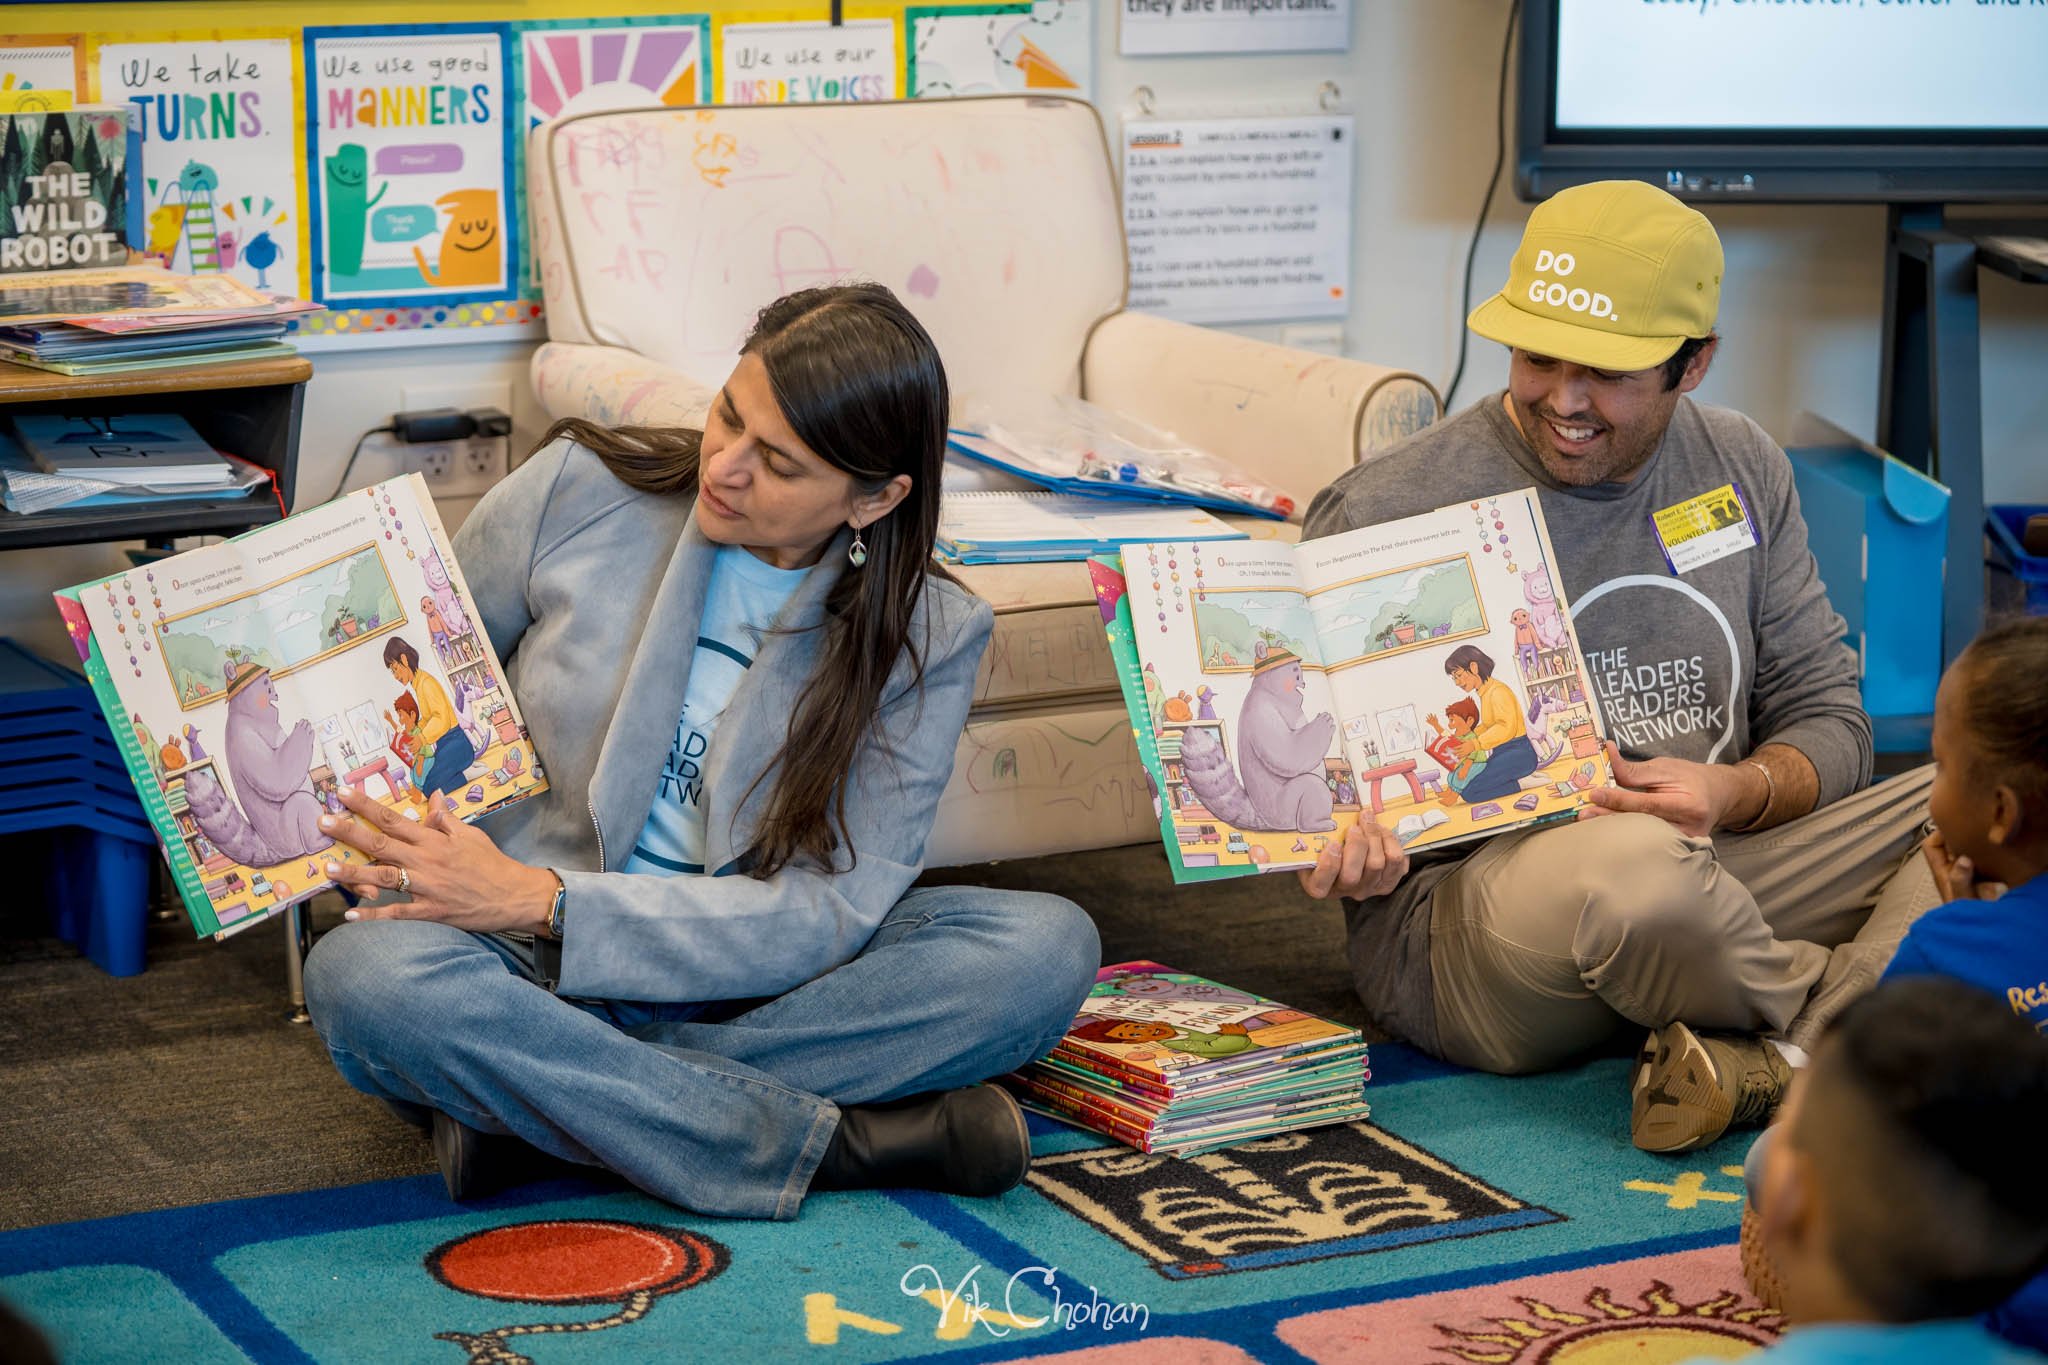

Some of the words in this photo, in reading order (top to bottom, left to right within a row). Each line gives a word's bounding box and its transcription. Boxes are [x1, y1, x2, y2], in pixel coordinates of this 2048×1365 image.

[1126, 0, 1173, 17] they
[1181, 0, 1215, 12] are
[1221, 0, 1337, 14] important.
[122, 57, 171, 87] We
[189, 52, 261, 83] take
[323, 55, 362, 78] We
[375, 56, 415, 74] use
[428, 47, 489, 81] good
[735, 47, 772, 69] We
[785, 48, 821, 64] use
[834, 48, 876, 63] our
[25, 172, 91, 199] THE
[11, 200, 107, 233] WILD
[0, 232, 118, 268] ROBOT
[1534, 249, 1576, 276] DO
[1528, 279, 1618, 322] GOOD.
[1667, 525, 1713, 548] VOLUNTEER
[1586, 646, 1629, 673] THE
[1595, 655, 1704, 698] LEADERS
[1604, 681, 1707, 725] READERS
[1612, 705, 1724, 750] NETWORK
[1126, 999, 1179, 1018] UPON
[1179, 1003, 1249, 1029] FRIEND
